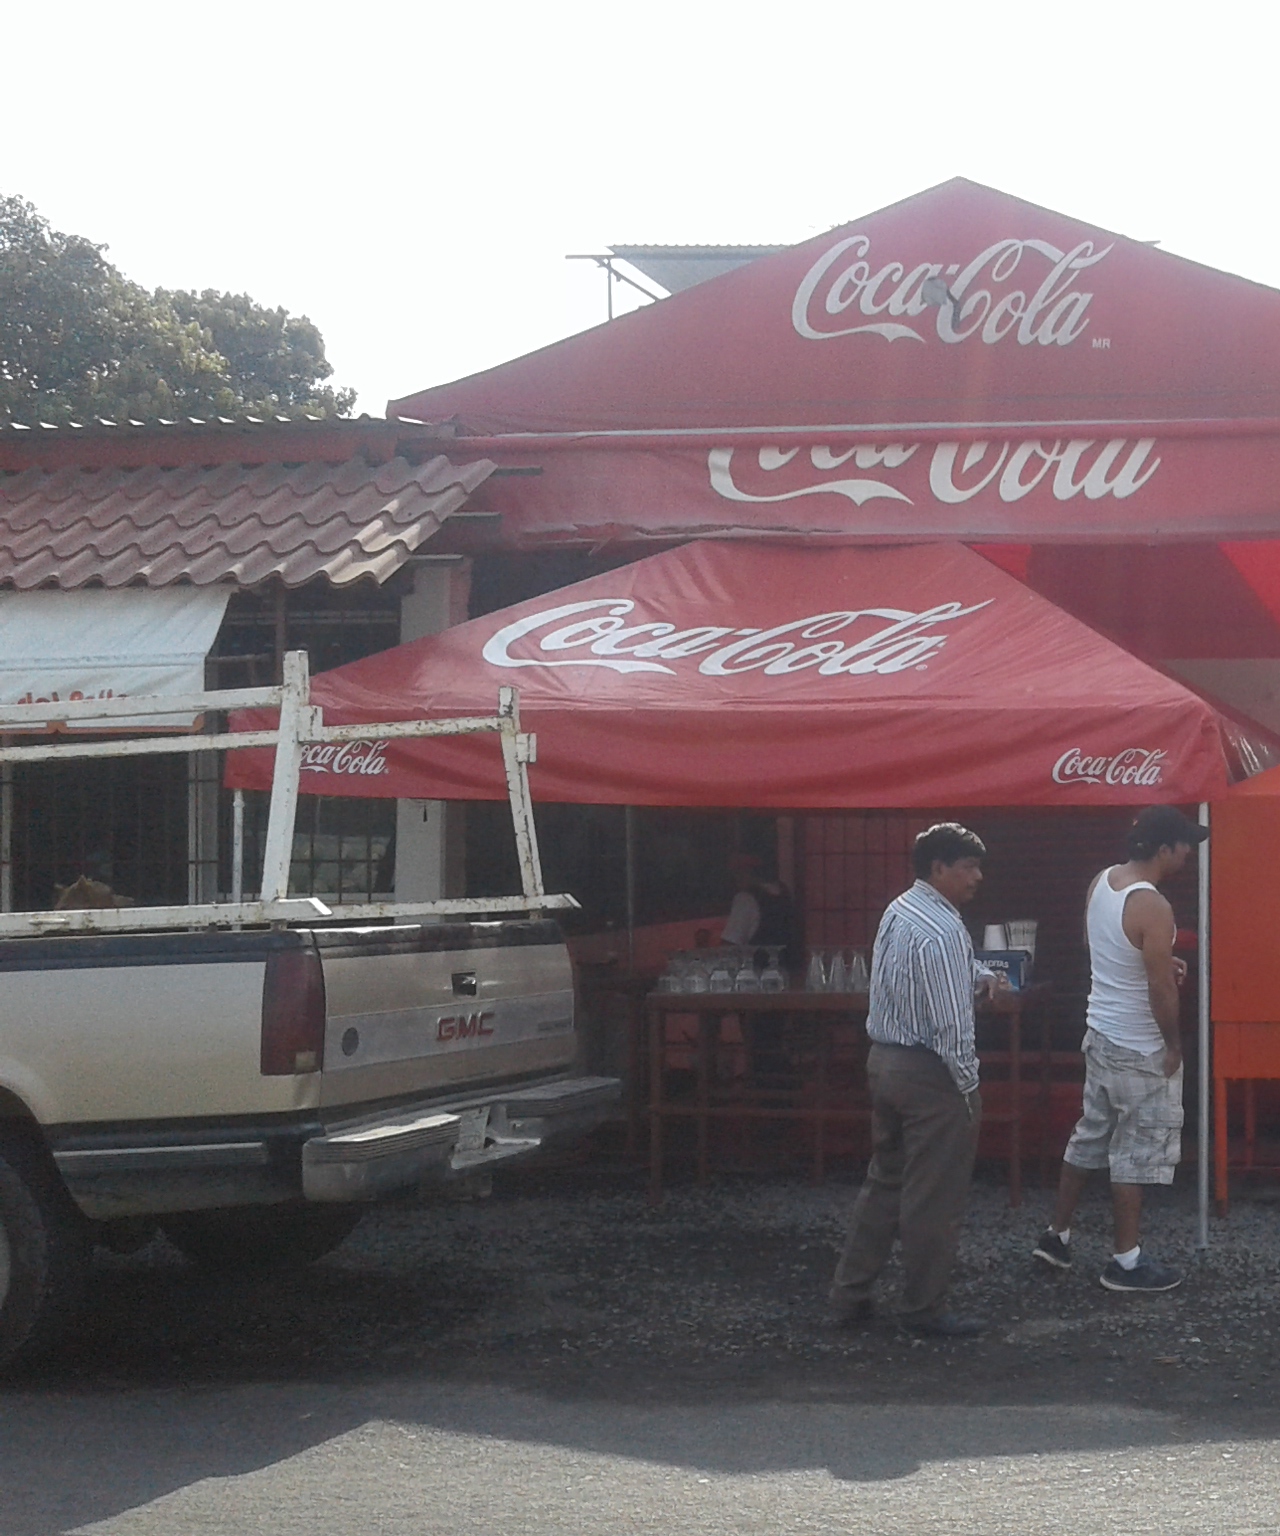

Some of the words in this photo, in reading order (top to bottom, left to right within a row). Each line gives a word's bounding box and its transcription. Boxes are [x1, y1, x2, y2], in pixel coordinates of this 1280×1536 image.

[792, 235, 1114, 345] Coca-Cola
[1092, 338, 1111, 348] MR
[482, 598, 995, 675] Coca-Cola
[299, 740, 390, 775] oca-Cola
[1052, 747, 1168, 785] Coca-Cola
[982, 959, 1009, 969] ADITAS
[437, 1011, 495, 1041] GMC
